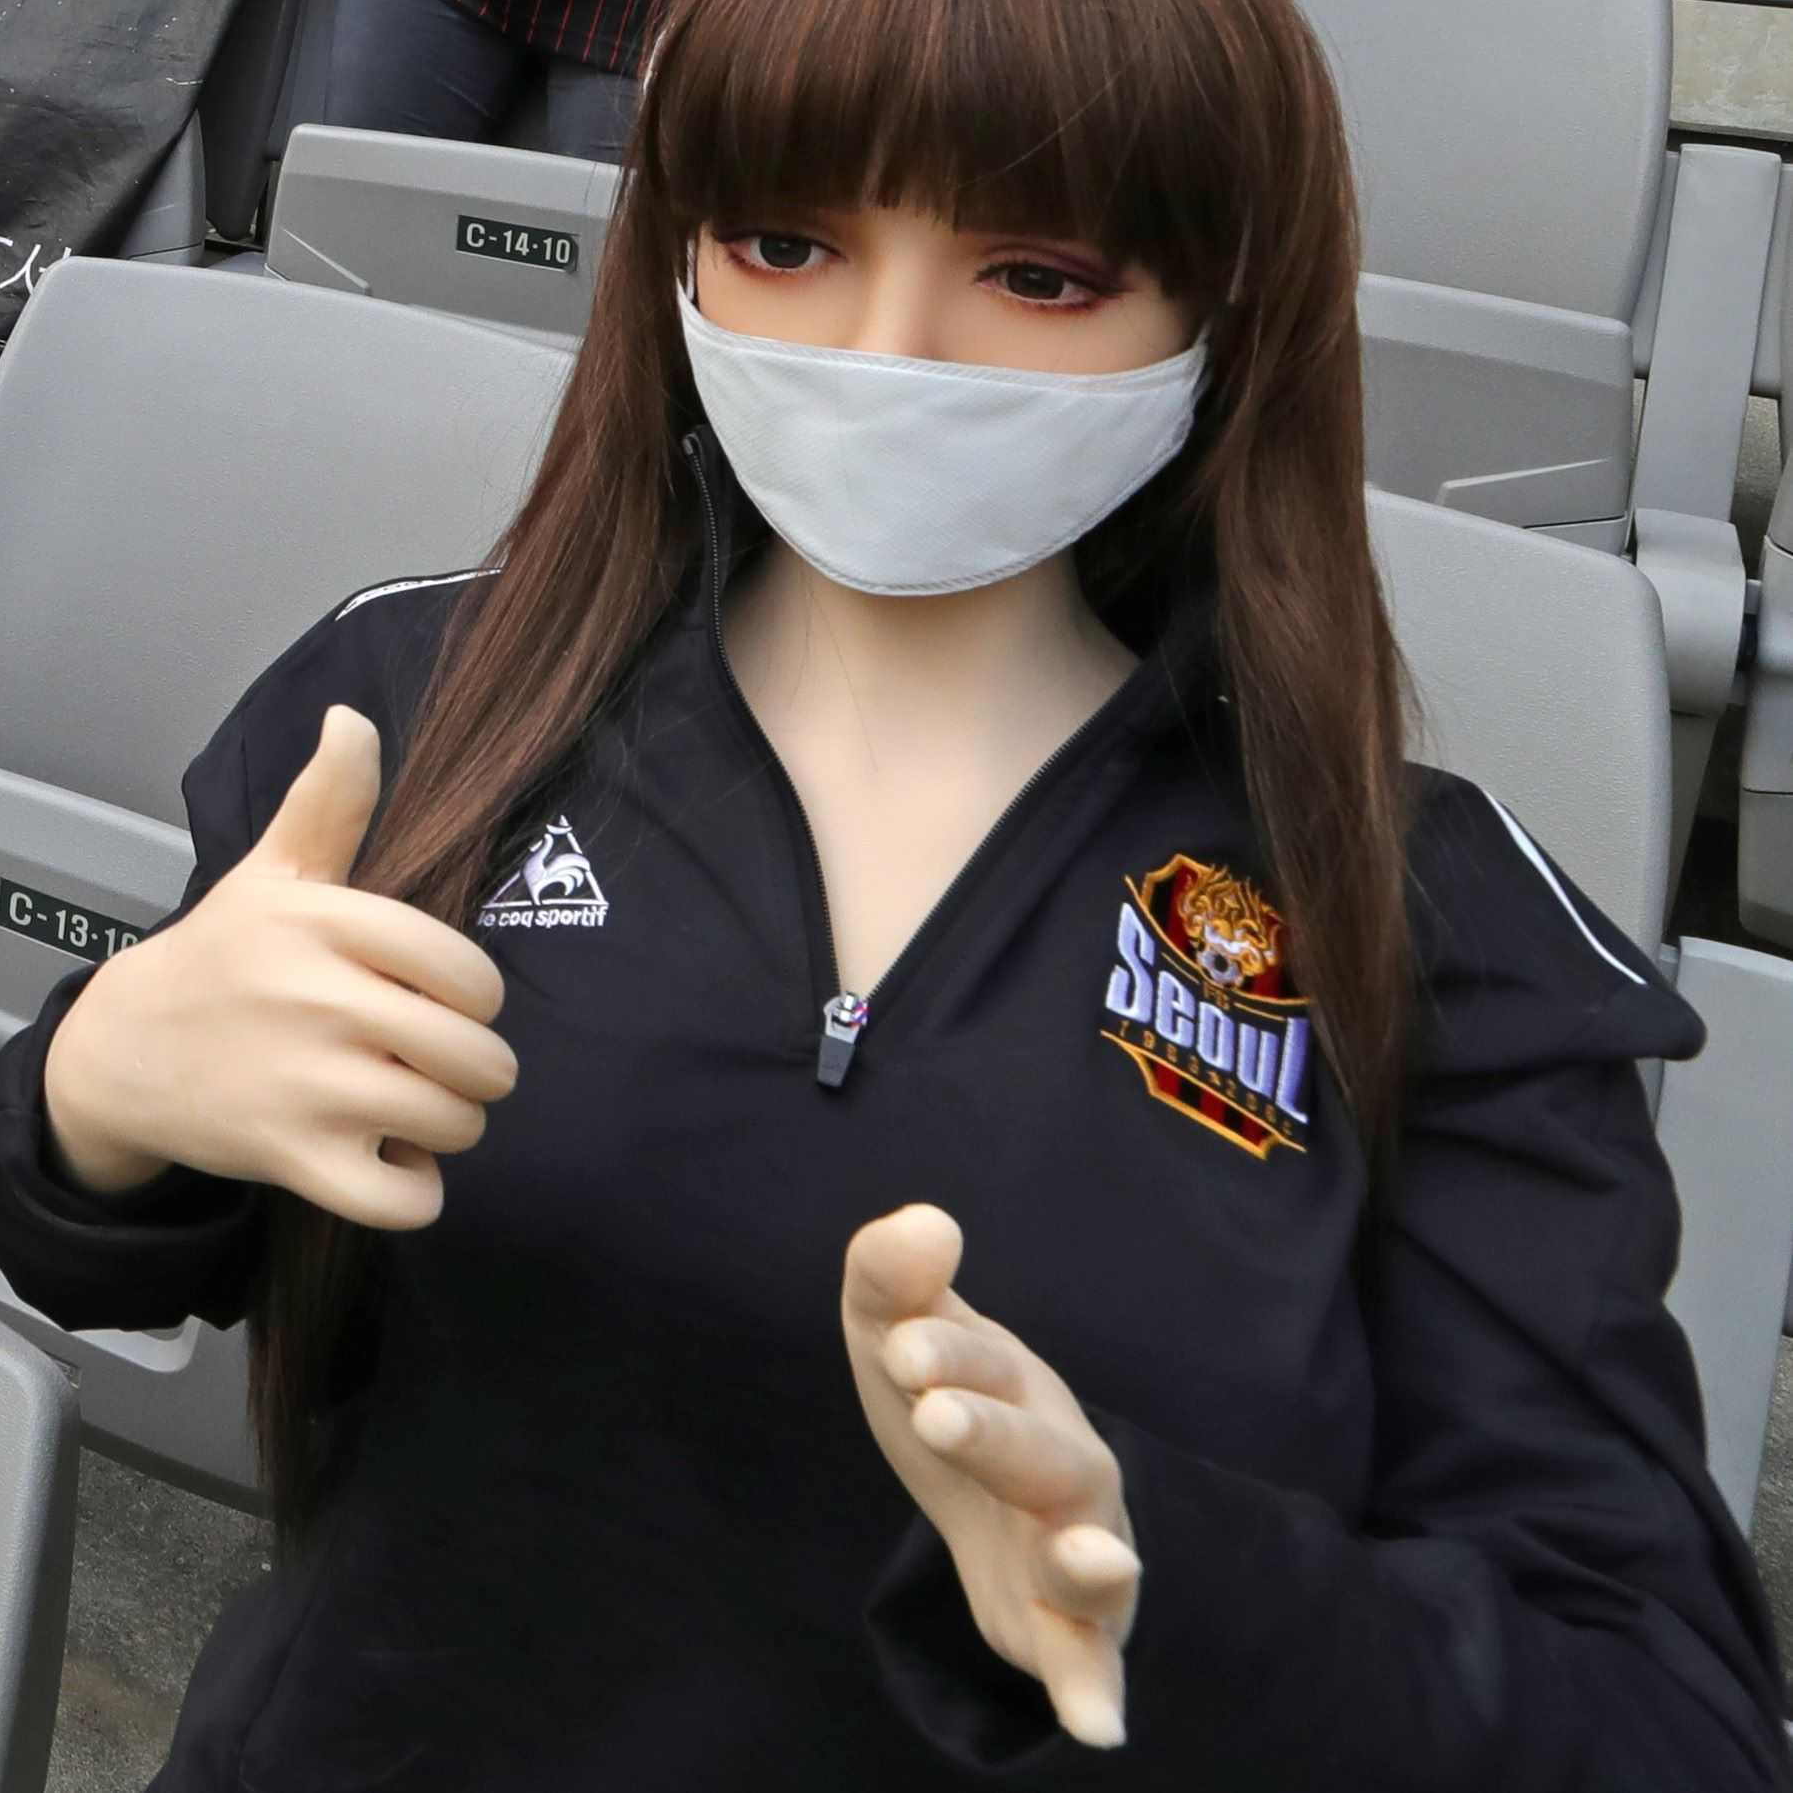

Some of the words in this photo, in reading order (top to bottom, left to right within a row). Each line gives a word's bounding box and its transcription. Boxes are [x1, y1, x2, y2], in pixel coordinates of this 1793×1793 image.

[498, 910, 534, 928] coq
[535, 906, 610, 929] sportif
[1104, 902, 1310, 1125] Seoul
